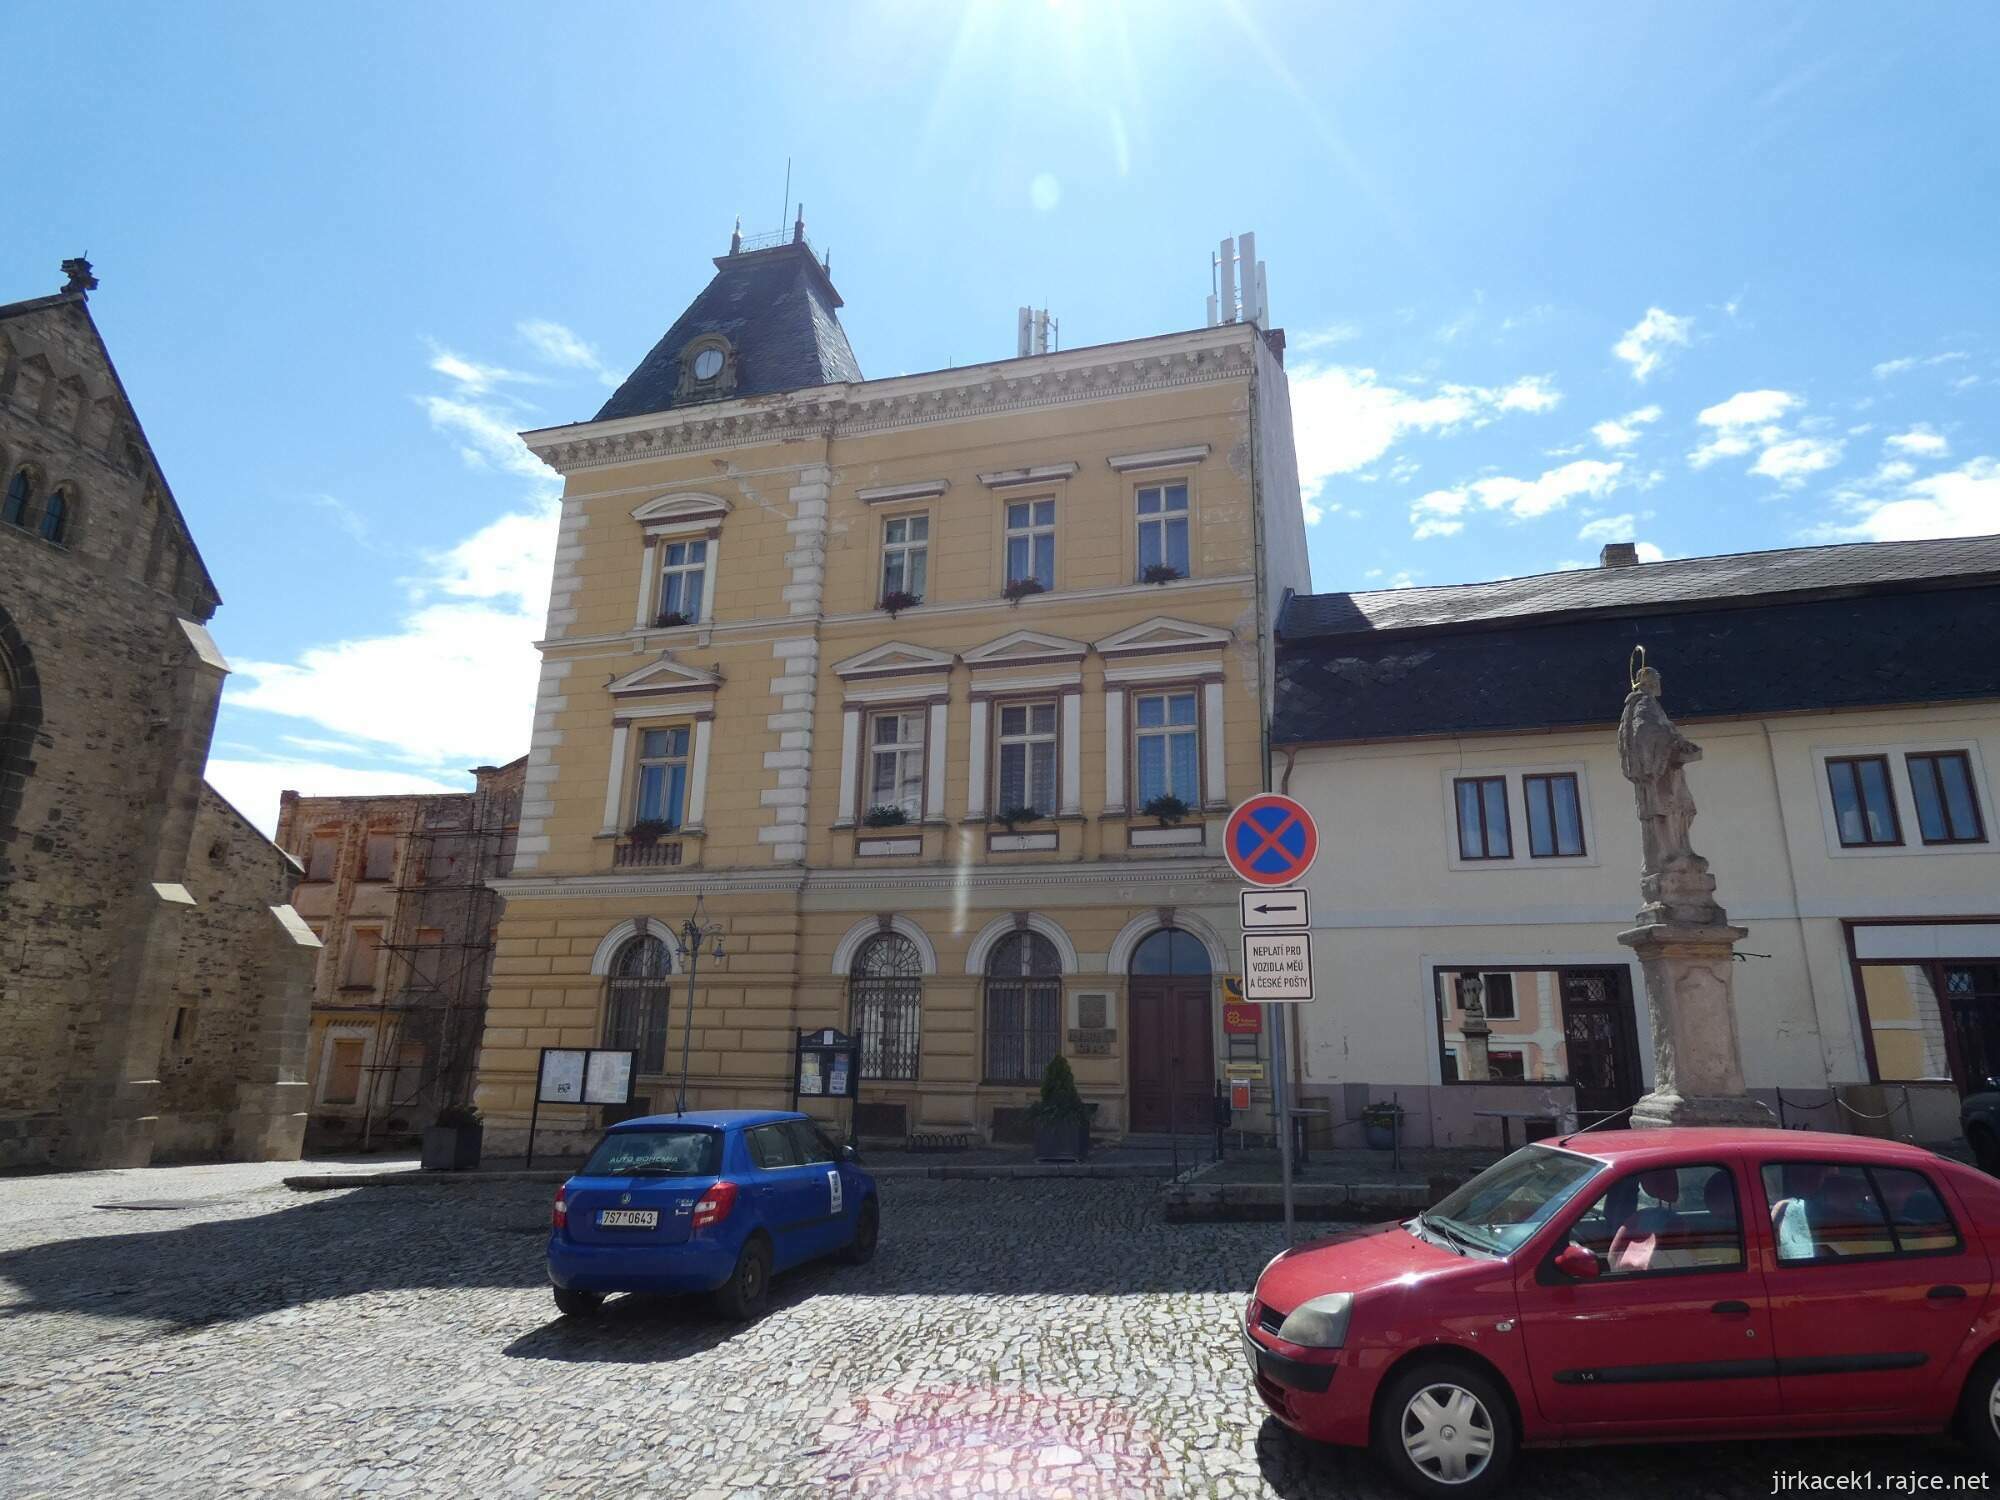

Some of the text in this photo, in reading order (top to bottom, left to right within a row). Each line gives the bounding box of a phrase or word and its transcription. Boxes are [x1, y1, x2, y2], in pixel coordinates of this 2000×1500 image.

[1253, 944, 1301, 957] NEPLATÍ PRO
[1252, 960, 1303, 972] VOZIDLA MĚÚ
[1250, 976, 1308, 988] A ČESKÉ POŠTY
[610, 1155, 634, 1163] AUTO
[604, 1212, 622, 1224] 7S7
[628, 1212, 653, 1224] 0643
